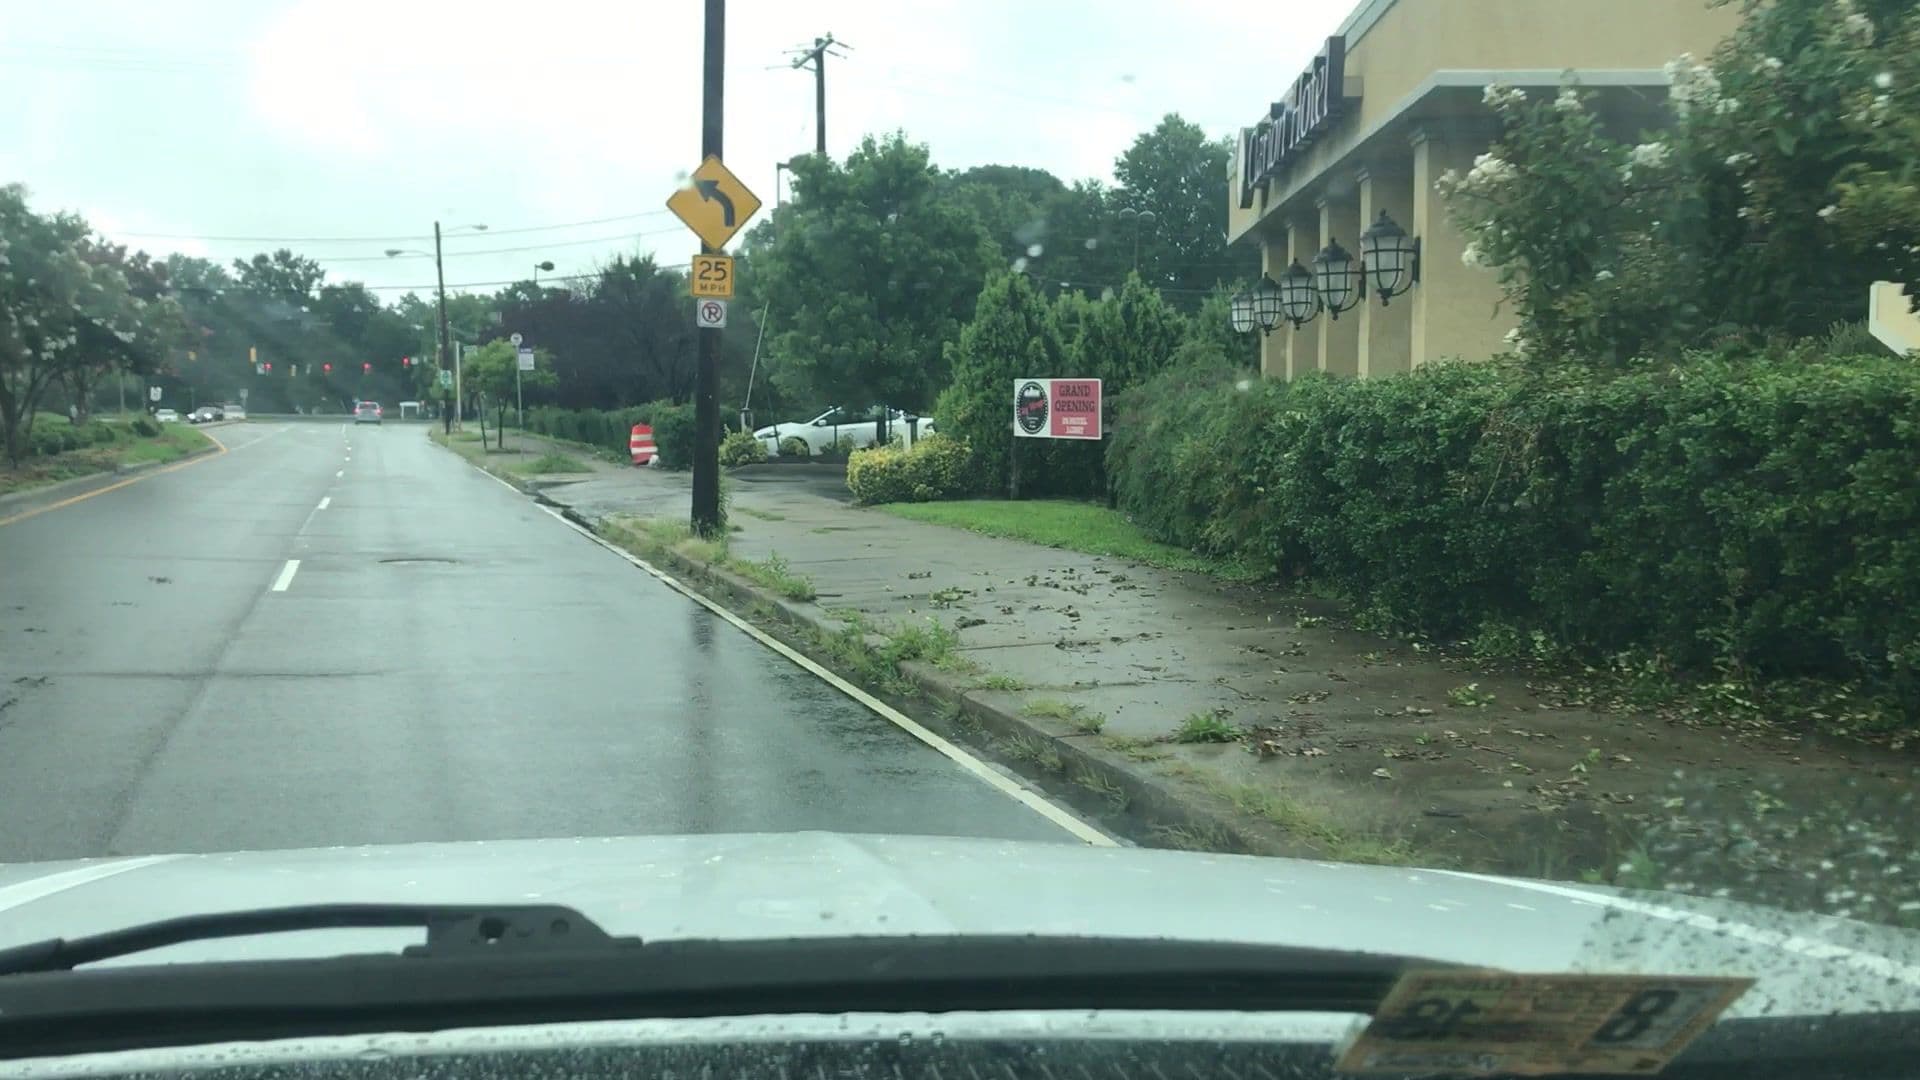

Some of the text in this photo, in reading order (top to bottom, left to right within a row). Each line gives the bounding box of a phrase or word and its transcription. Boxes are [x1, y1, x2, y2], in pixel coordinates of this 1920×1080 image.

[1289, 36, 1329, 149] Hotel
[699, 261, 727, 281] 25
[700, 283, 726, 293] MPH
[1059, 384, 1091, 397] GRAND
[1055, 400, 1095, 413] OPENING
